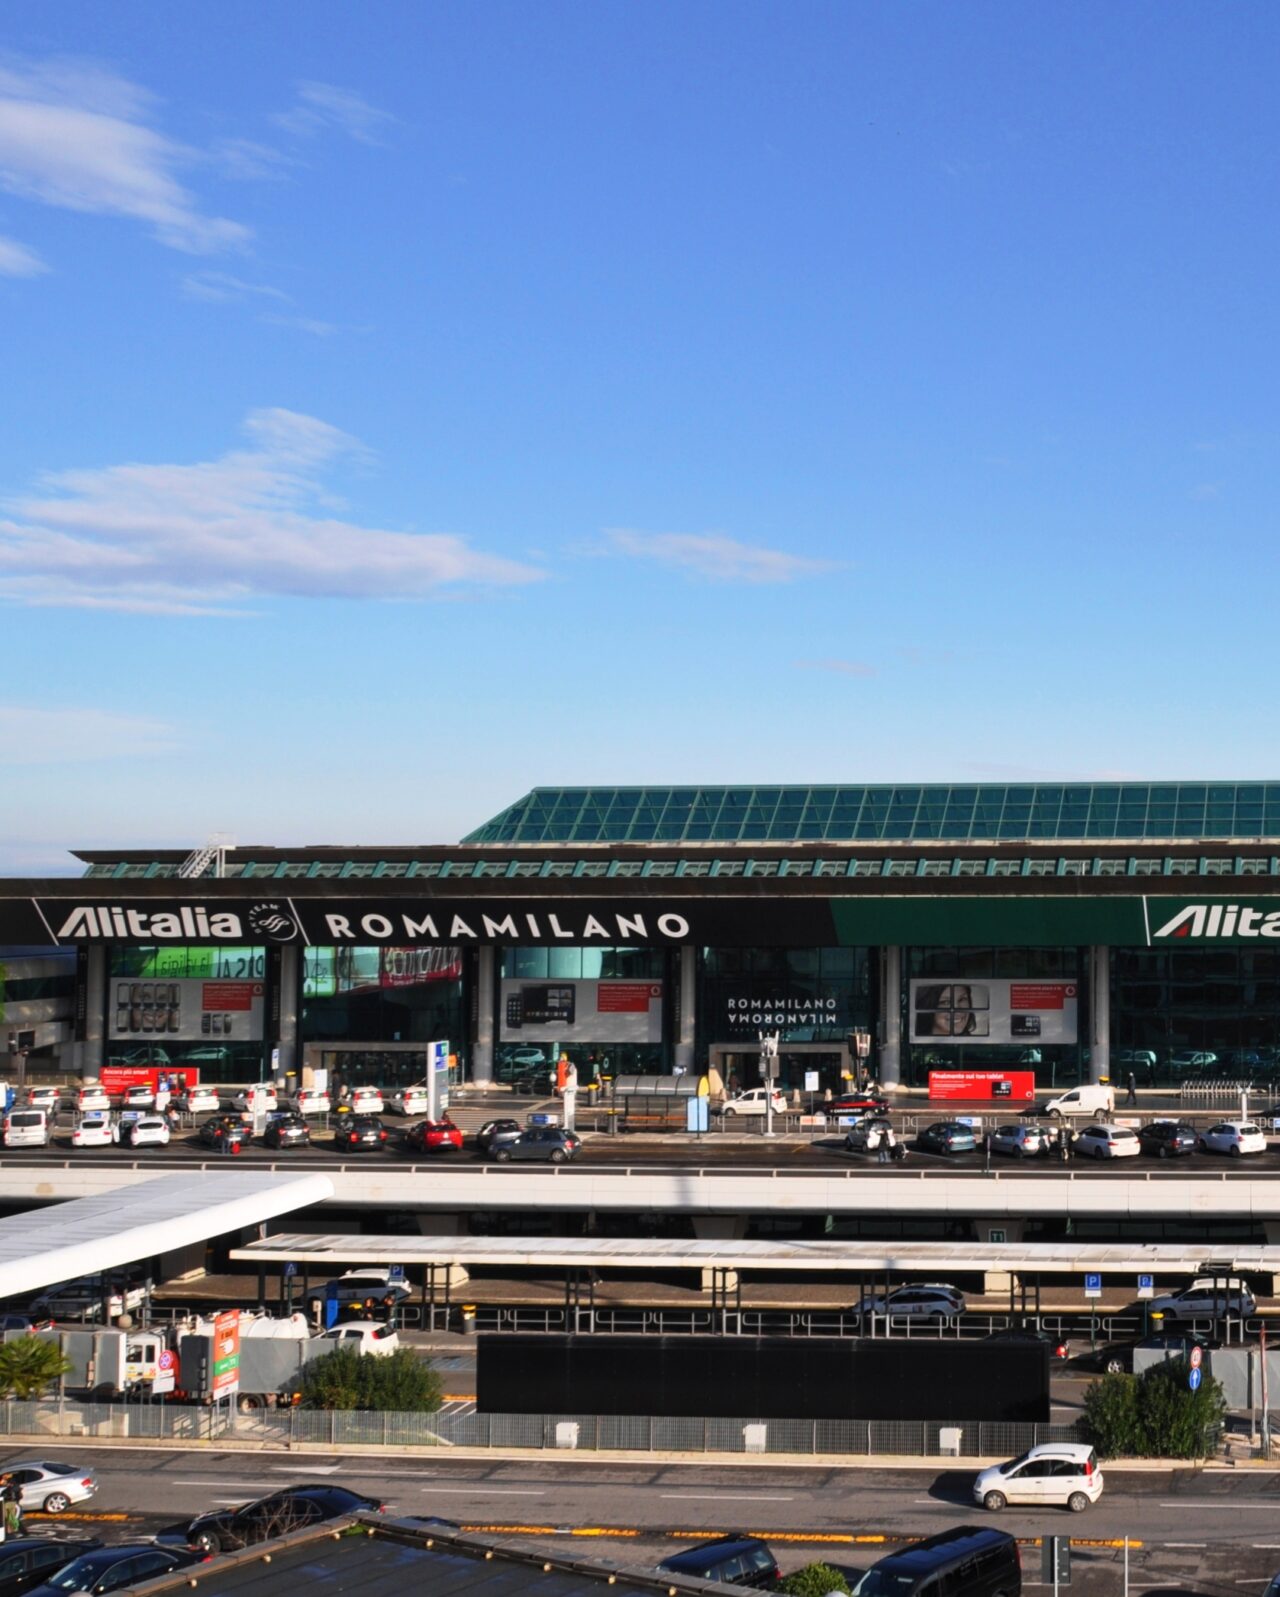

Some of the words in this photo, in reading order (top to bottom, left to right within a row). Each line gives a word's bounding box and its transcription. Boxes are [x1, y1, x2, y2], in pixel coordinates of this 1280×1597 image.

[57, 906, 243, 939] Alitalia
[325, 913, 690, 938] ROMAMILANO
[727, 998, 837, 1009] ROMAMILANO
